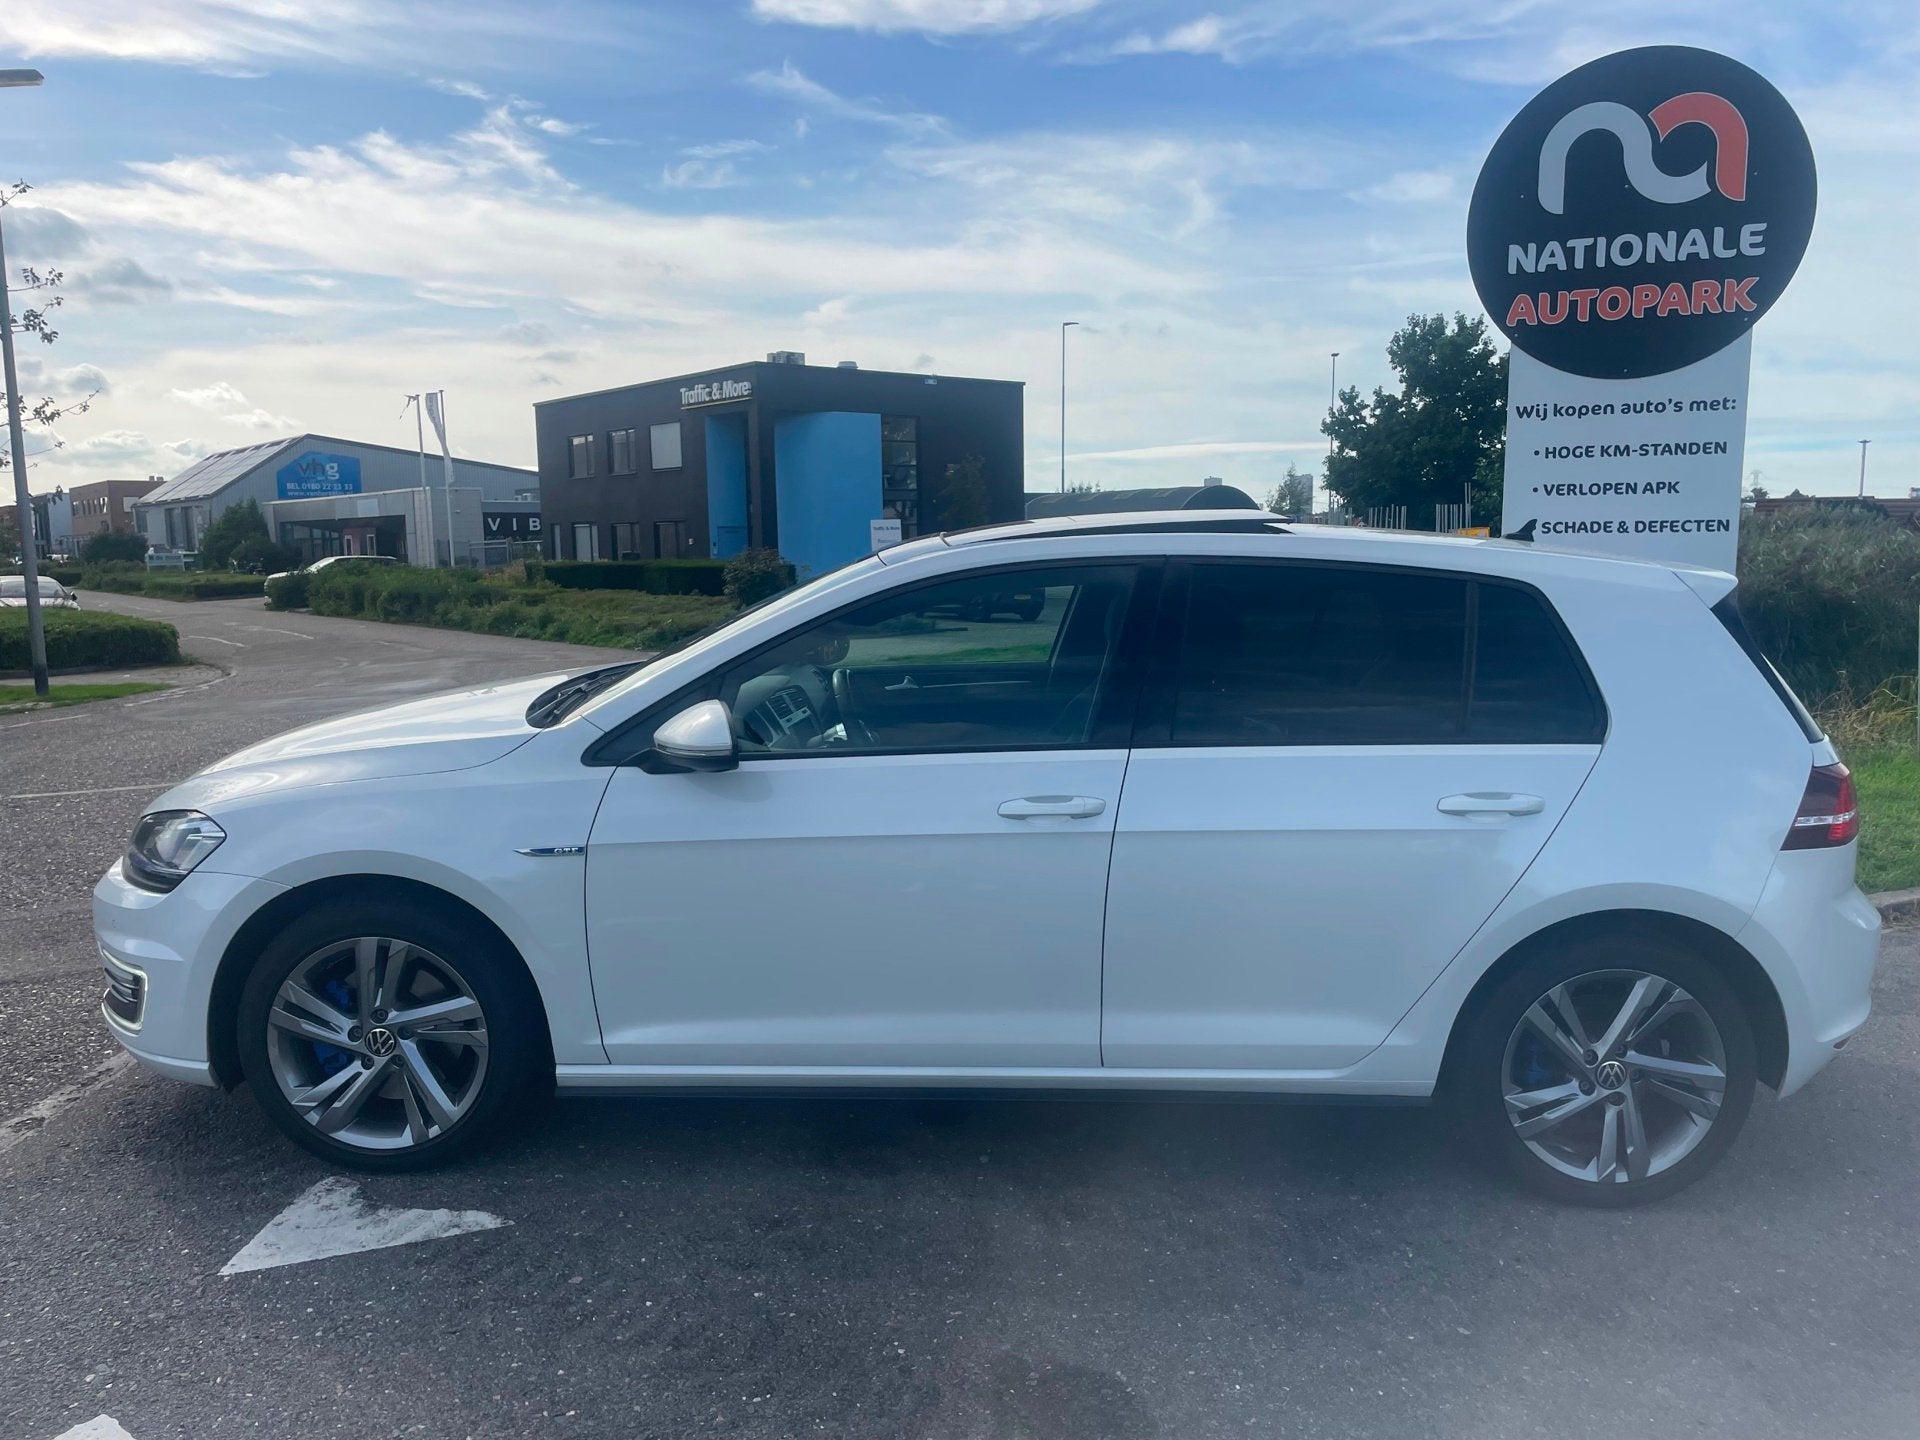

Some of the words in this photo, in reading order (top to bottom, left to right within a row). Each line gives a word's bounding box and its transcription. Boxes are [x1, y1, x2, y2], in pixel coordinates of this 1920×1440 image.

[1507, 222, 1768, 275] NATIONALE
[1505, 276, 1760, 327] AUTOPARK
[680, 383, 712, 405] Traffic
[712, 382, 720, 400] &
[722, 380, 752, 398] More
[1515, 403, 1548, 421] Wij
[1553, 402, 1615, 420] kopen
[1620, 398, 1683, 415] auto's
[1689, 396, 1737, 412] met:
[1544, 444, 1595, 460] HOGE
[1600, 441, 1728, 458] KM-STANDEN
[1543, 481, 1638, 497] VERLOPEN
[1642, 480, 1681, 495] APK
[487, 517, 541, 531] VIB
[1541, 520, 1614, 535] SCHADE
[1616, 520, 1630, 534] &
[1634, 519, 1730, 534] DEFECTEN
